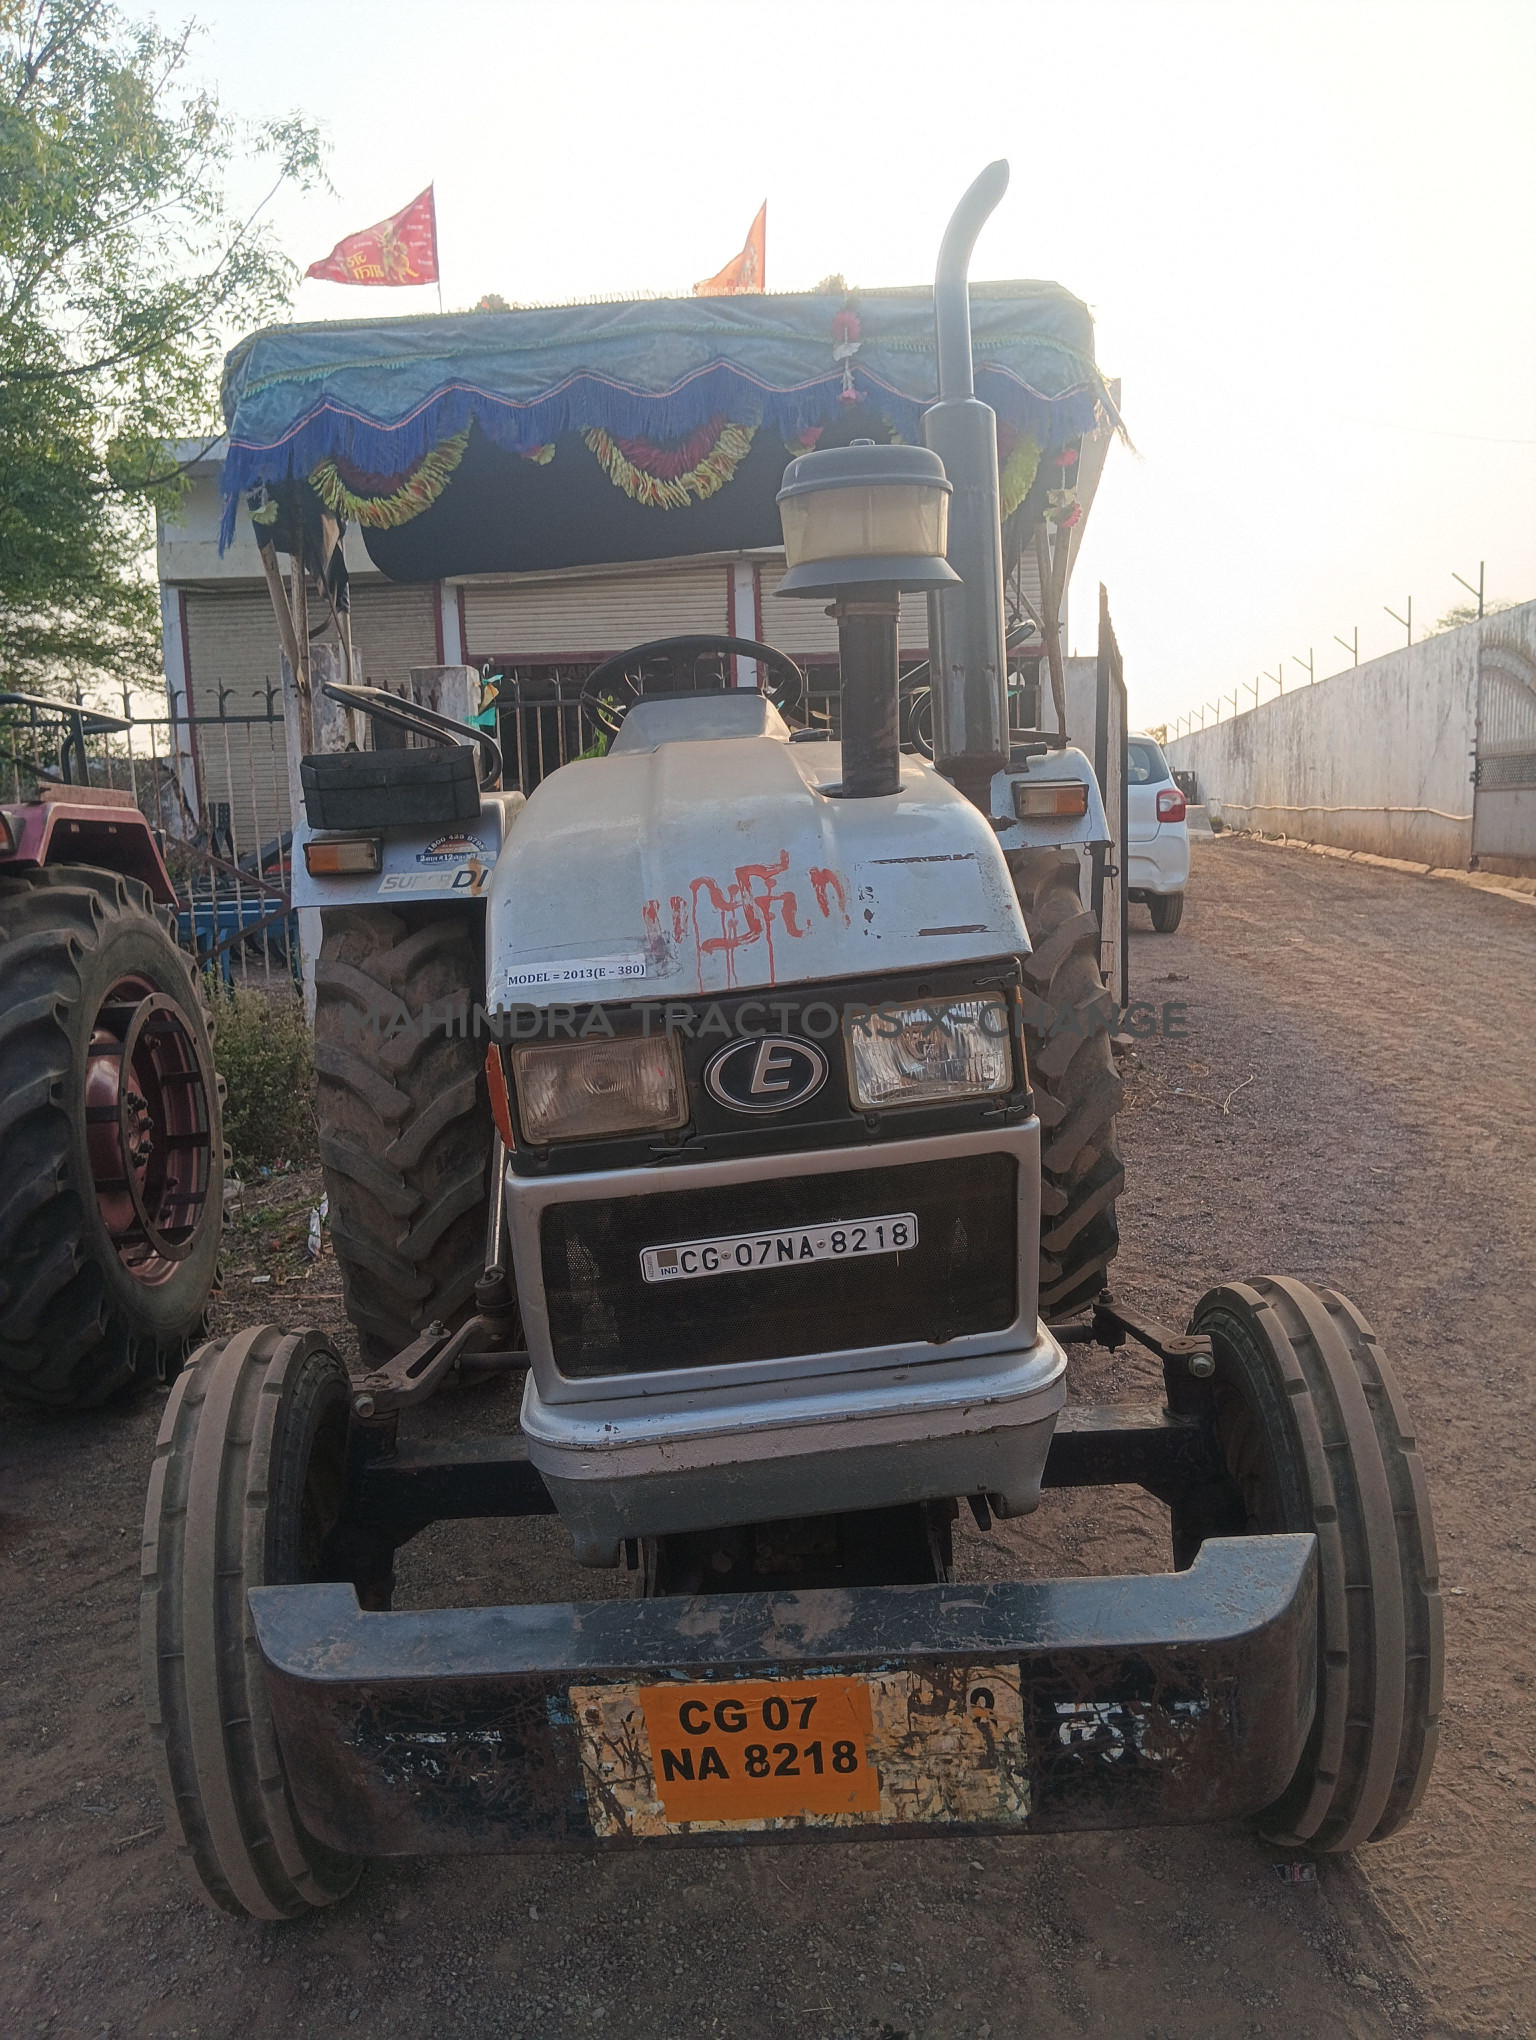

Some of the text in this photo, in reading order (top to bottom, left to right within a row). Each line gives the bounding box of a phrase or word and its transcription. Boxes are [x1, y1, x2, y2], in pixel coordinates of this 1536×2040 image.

[452, 870, 489, 888] DI
[508, 972, 550, 985] MODEL
[563, 967, 606, 981] 2013(E
[618, 963, 645, 976] 380)
[830, 1222, 908, 1253] 8218
[660, 1266, 678, 1276] IND
[679, 1696, 818, 1735] CG 07
[661, 1740, 858, 1782] NA 8218
